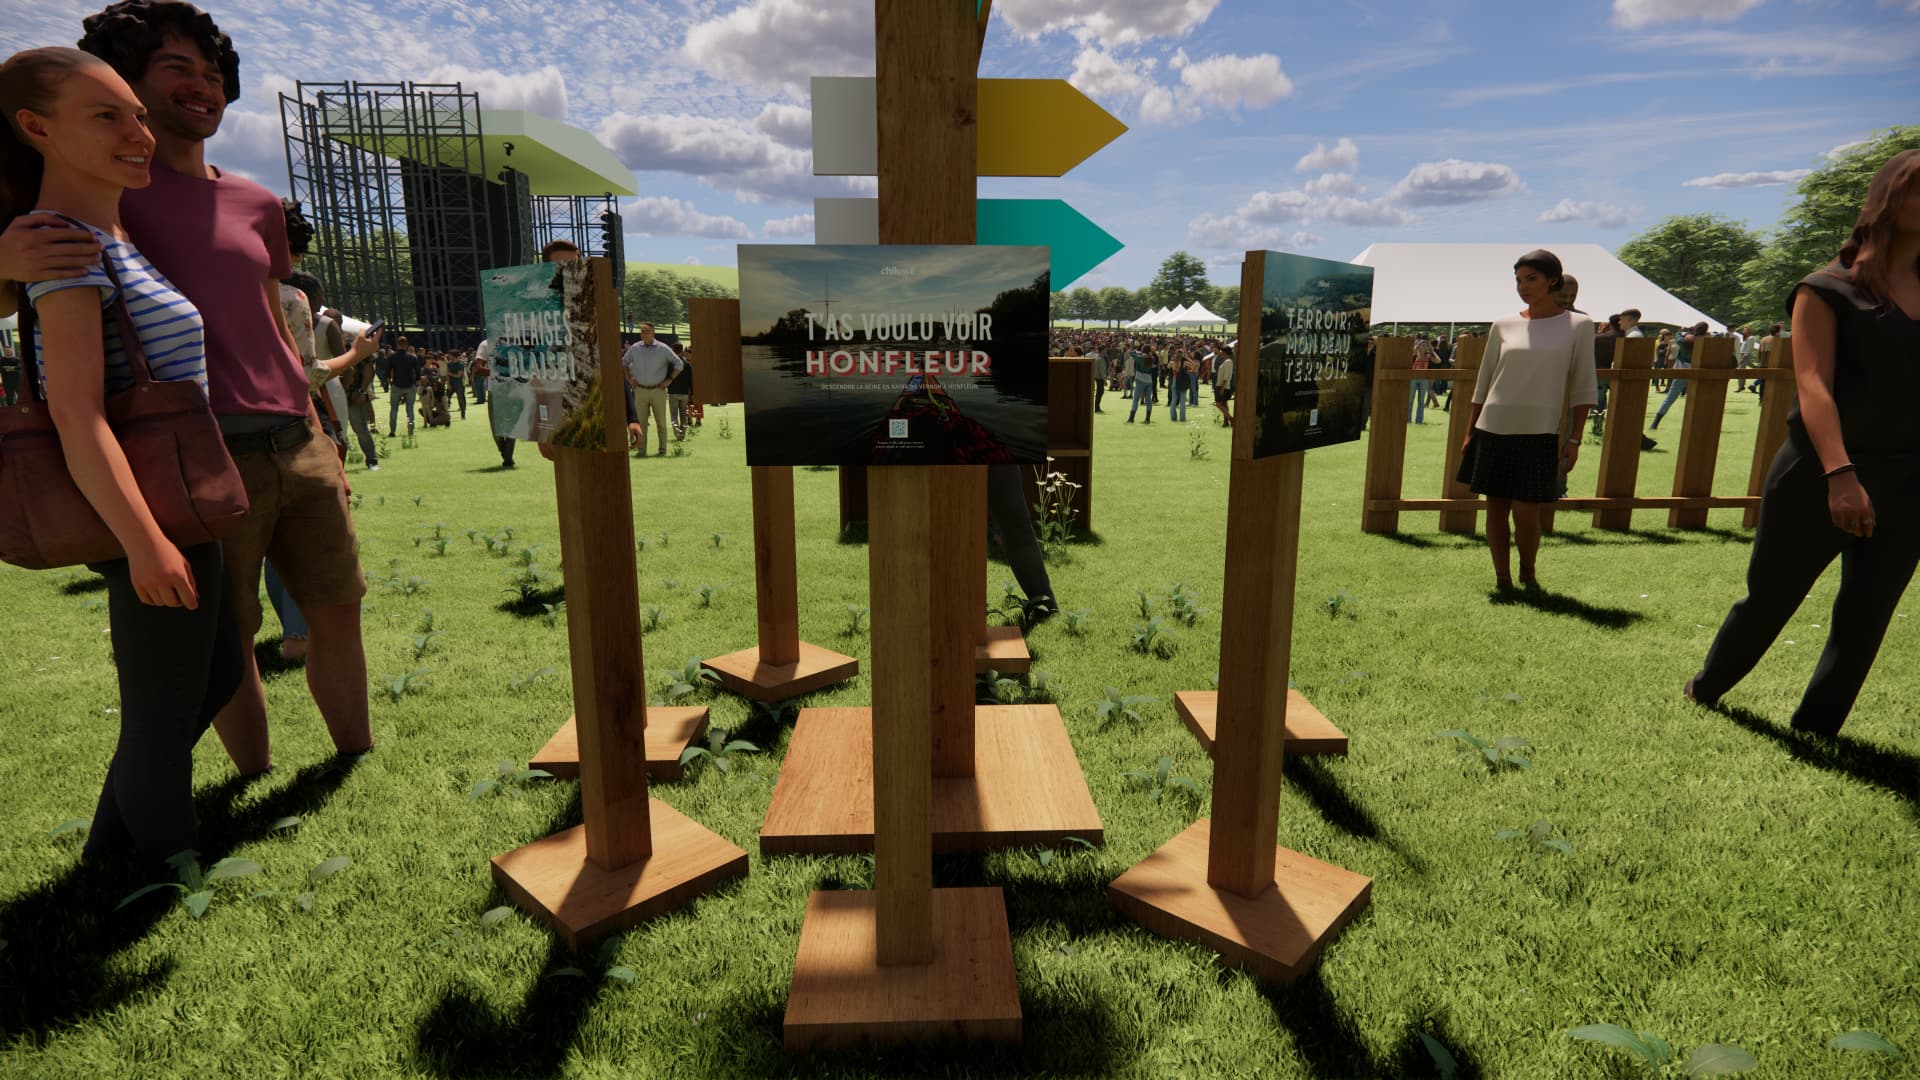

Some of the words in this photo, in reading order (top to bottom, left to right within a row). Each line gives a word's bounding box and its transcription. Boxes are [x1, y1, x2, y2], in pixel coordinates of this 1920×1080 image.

[505, 311, 573, 346] FALAISES
[804, 312, 854, 342] T'AS
[861, 312, 934, 342] VOULU
[942, 312, 993, 342] VOIR
[1287, 308, 1351, 331] TERROIR,
[1285, 332, 1318, 355] MON
[1319, 332, 1351, 355] BEAU
[806, 350, 992, 377] HONFLEUR
[1284, 358, 1348, 382] TERROIR
